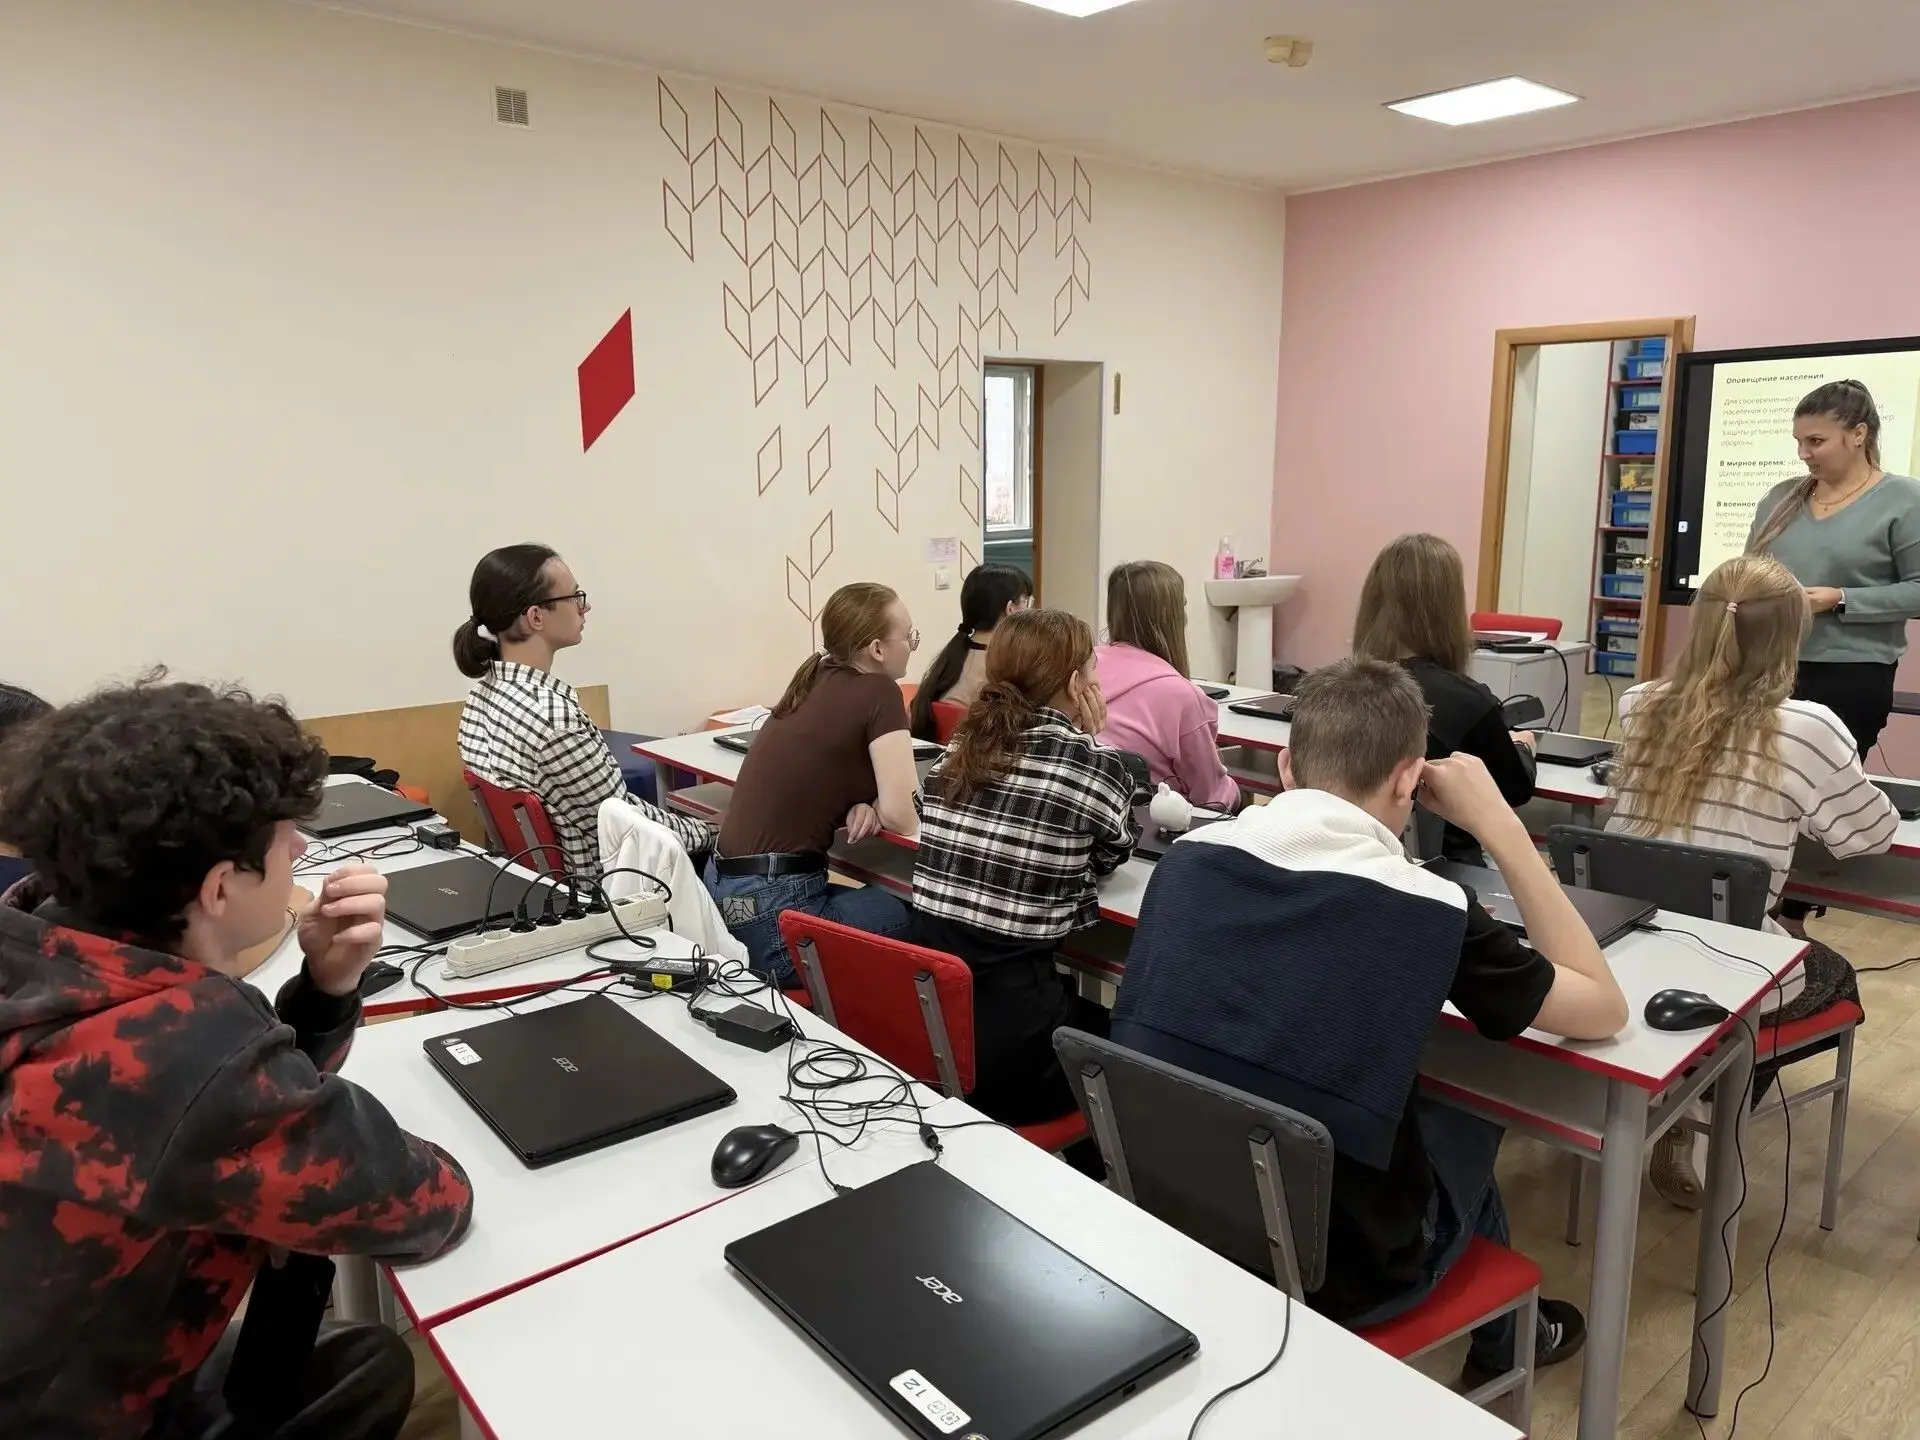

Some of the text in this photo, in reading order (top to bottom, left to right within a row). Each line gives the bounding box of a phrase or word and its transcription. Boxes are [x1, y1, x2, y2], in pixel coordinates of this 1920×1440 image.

[1726, 373, 1825, 385] Оповещение населения
[1726, 460, 1757, 468] мирное
[1758, 459, 1786, 468] время:
[551, 1057, 579, 1073] acer
[914, 1275, 964, 1305] acer
[903, 1378, 928, 1399] 12
